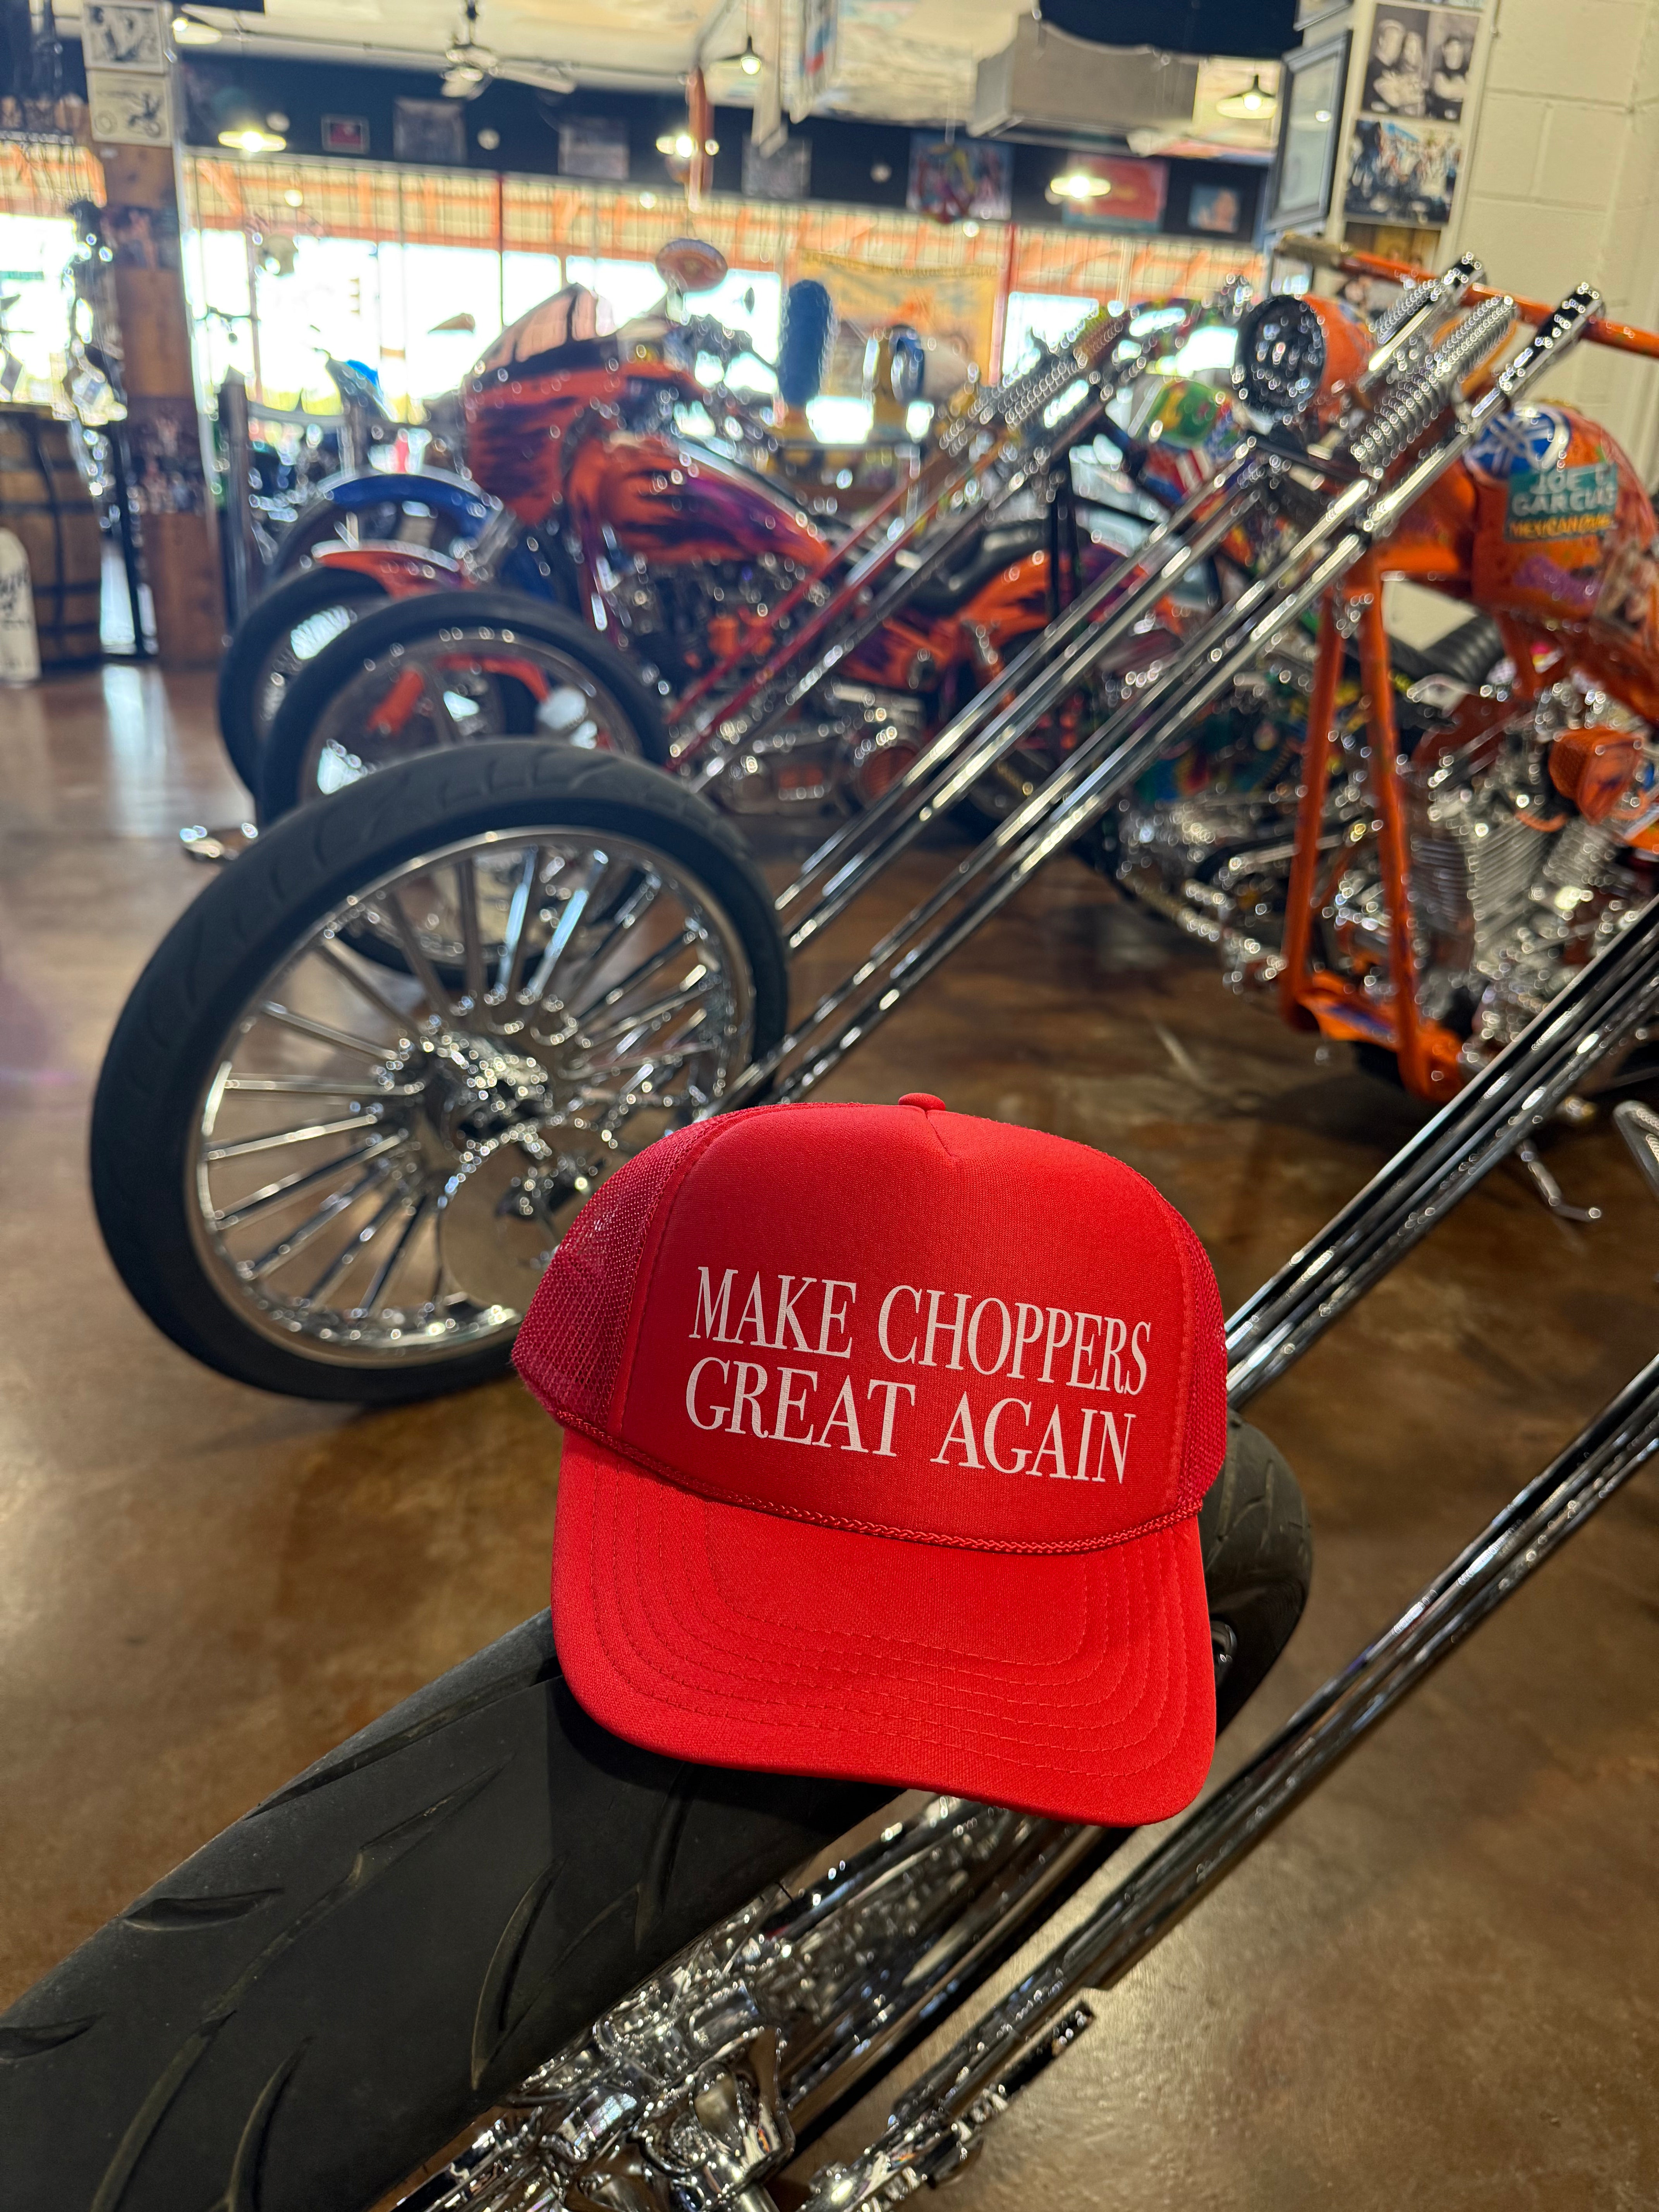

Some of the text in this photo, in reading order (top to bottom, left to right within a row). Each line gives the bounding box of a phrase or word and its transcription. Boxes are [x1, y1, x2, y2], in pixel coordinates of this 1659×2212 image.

[689, 1266, 1151, 1395] MAKE CHOPPERS
[686, 1357, 1136, 1484] GREAT AGAIN
